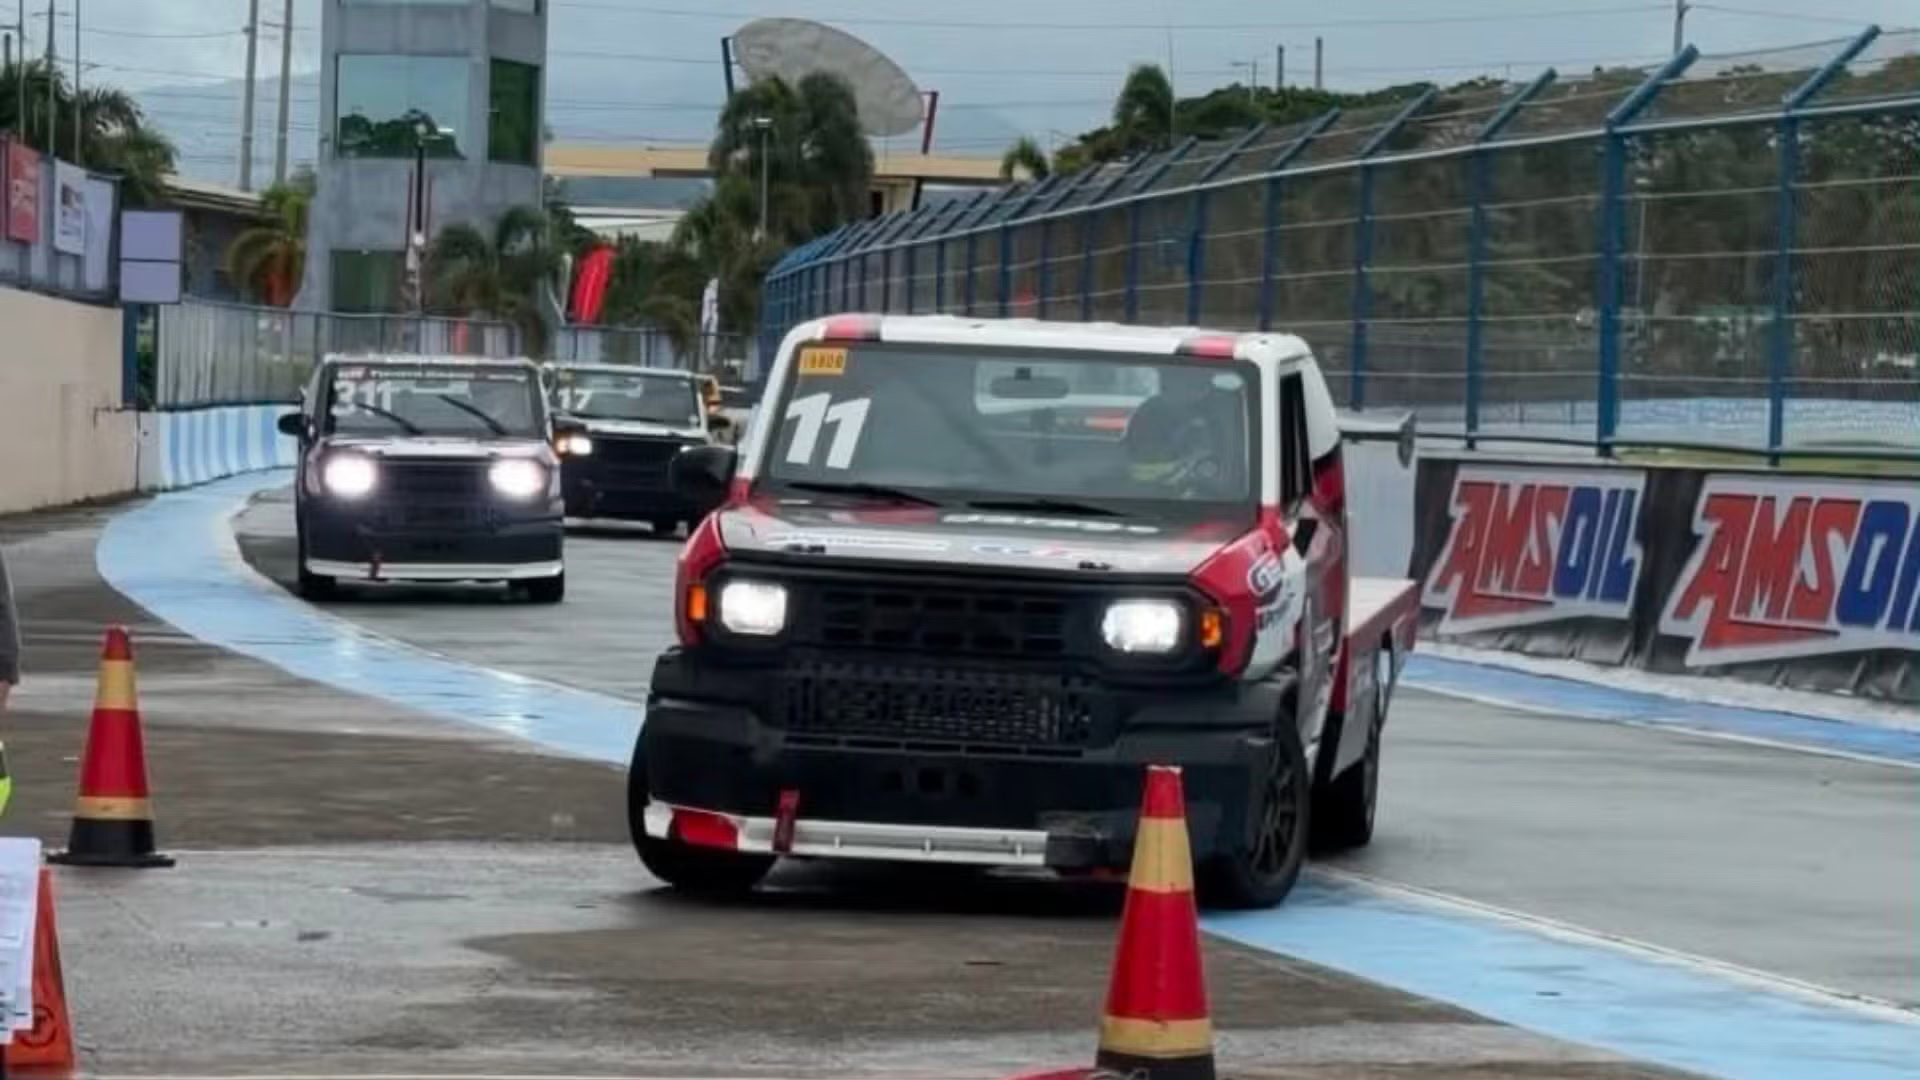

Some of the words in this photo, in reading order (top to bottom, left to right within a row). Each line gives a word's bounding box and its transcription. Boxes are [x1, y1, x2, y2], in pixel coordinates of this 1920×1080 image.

[557, 386, 593, 411] 17
[785, 392, 871, 469] 11
[1431, 480, 1638, 619] AMSOIL
[1672, 492, 1920, 650] AMSOI
